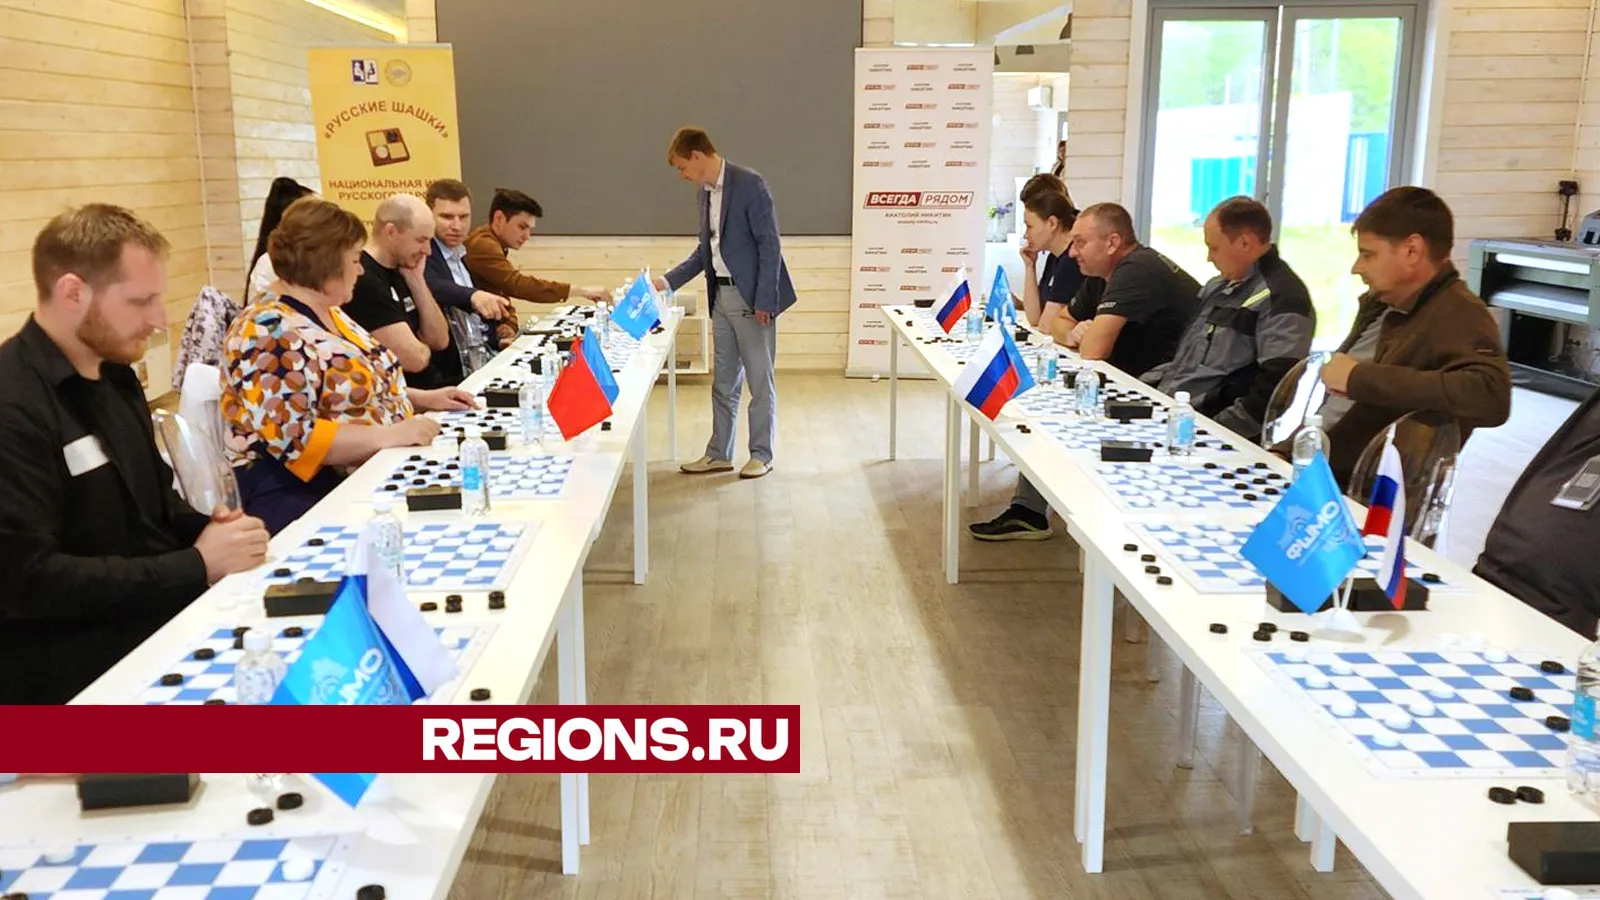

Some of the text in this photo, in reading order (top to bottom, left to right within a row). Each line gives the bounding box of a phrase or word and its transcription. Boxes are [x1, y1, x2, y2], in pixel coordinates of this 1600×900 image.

[325, 100, 449, 139] «РУССКИЕ ШАШКИ»
[328, 179, 422, 189] НАЦИОНАЛЬНАЯ
[870, 194, 969, 205] ВСЕГДА РЯДОМ
